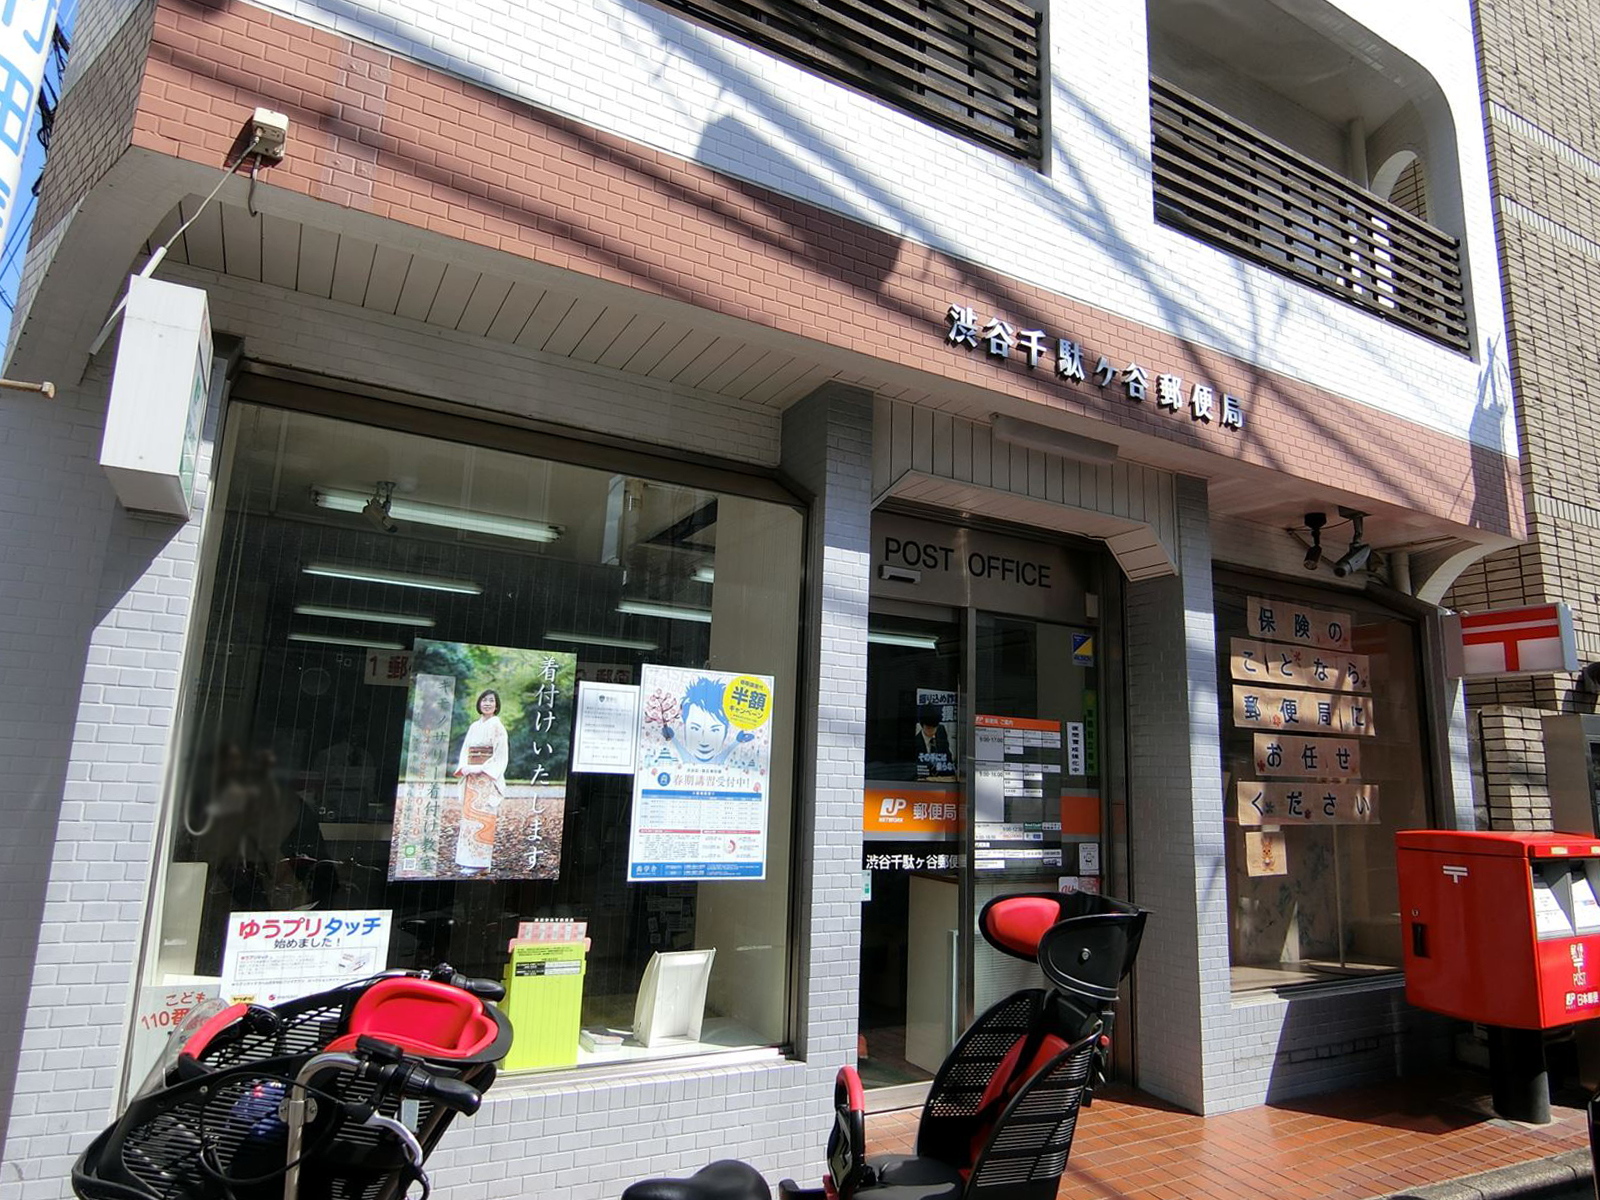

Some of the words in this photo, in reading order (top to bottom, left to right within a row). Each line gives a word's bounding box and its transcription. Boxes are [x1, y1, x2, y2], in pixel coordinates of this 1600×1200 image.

[885, 537, 954, 571] POST
[968, 553, 1052, 588] OFFICE
[1258, 606, 1343, 643] 保険の
[1243, 651, 1360, 685] ことなら
[731, 685, 767, 712] 半額
[1244, 694, 1365, 727] 郵便局に
[523, 656, 560, 870] 着付けいたします
[1266, 742, 1351, 770] お任せ
[879, 797, 907, 817] JP
[912, 803, 957, 820] 郵便局
[1251, 791, 1370, 817] ください
[865, 854, 960, 870] 渋谷千駄ヶ谷郵便
[238, 916, 382, 940] ゆうプリタッチ
[273, 937, 341, 950] 始めました!
